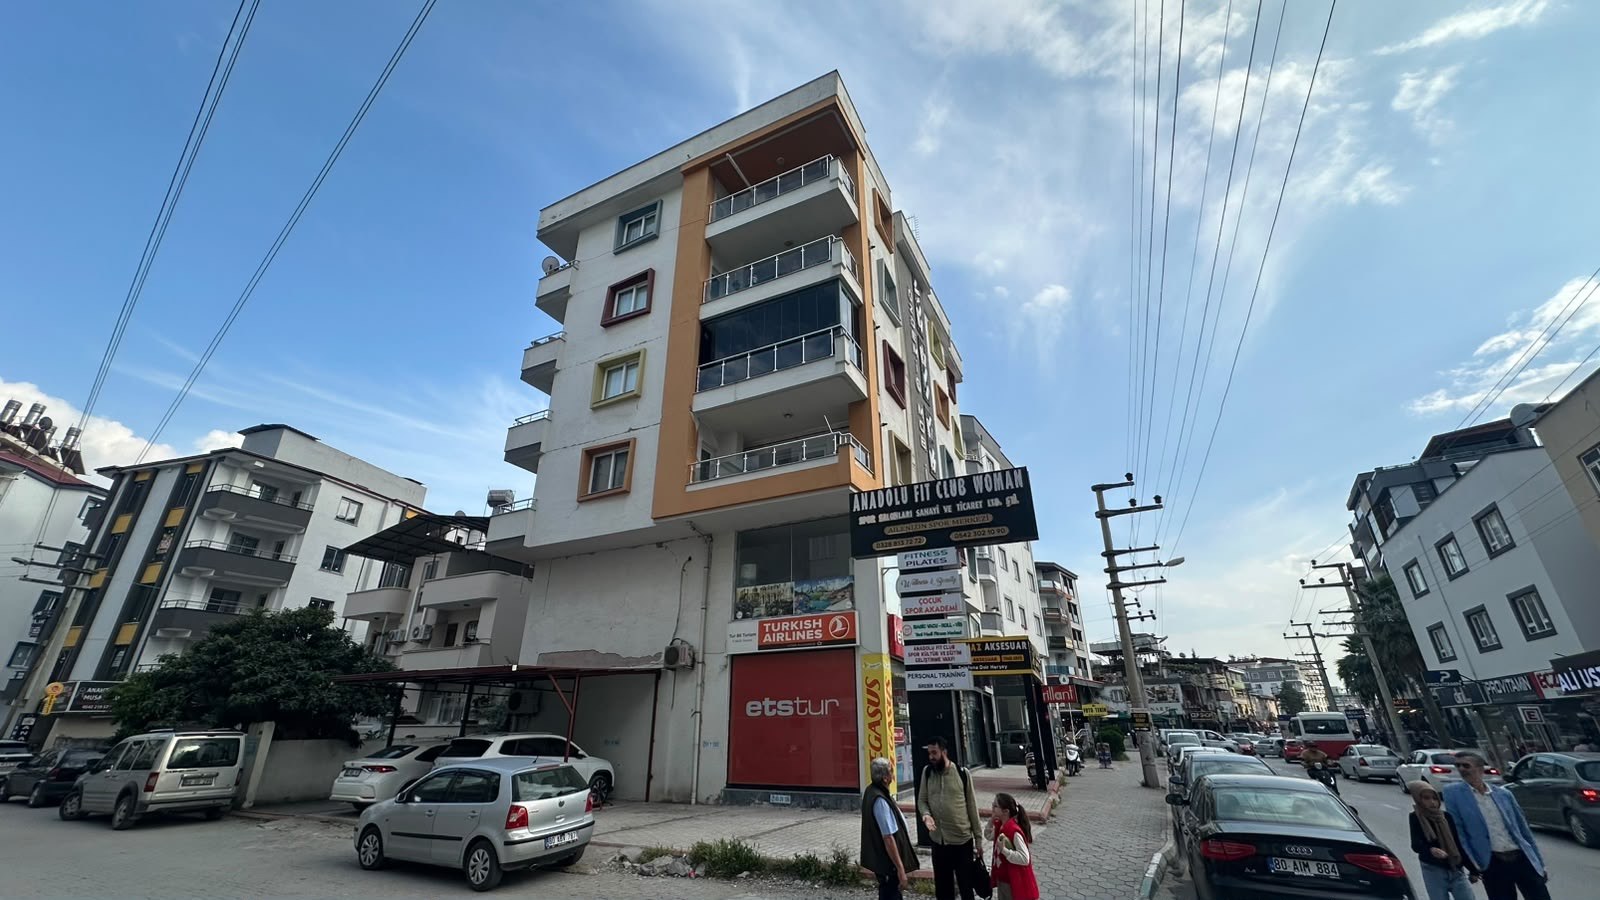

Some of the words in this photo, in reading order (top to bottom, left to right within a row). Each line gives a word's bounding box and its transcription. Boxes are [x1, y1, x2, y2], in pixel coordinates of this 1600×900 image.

[852, 488, 908, 512] ANADOLU
[914, 482, 930, 503] FIT
[936, 477, 966, 499] CLUB
[972, 470, 1024, 494] WOMAN
[916, 504, 940, 518] SANAYİ
[943, 504, 952, 513] VE
[956, 500, 983, 512] TİCARET
[928, 520, 950, 529] SPOR
[904, 550, 948, 559] FITNESS
[906, 557, 947, 567] PILATES
[763, 618, 822, 632] TURKISH
[762, 629, 823, 643] AIRLINES
[984, 641, 1028, 651] AKSESUAR
[1560, 667, 1582, 692] ALİ
[1042, 685, 1073, 701] rillant
[746, 697, 840, 716] etstur
[865, 676, 883, 761] EGASUS
[1274, 859, 1287, 870] 80
[1293, 861, 1310, 873] AIM
[1316, 863, 1338, 875] 884
